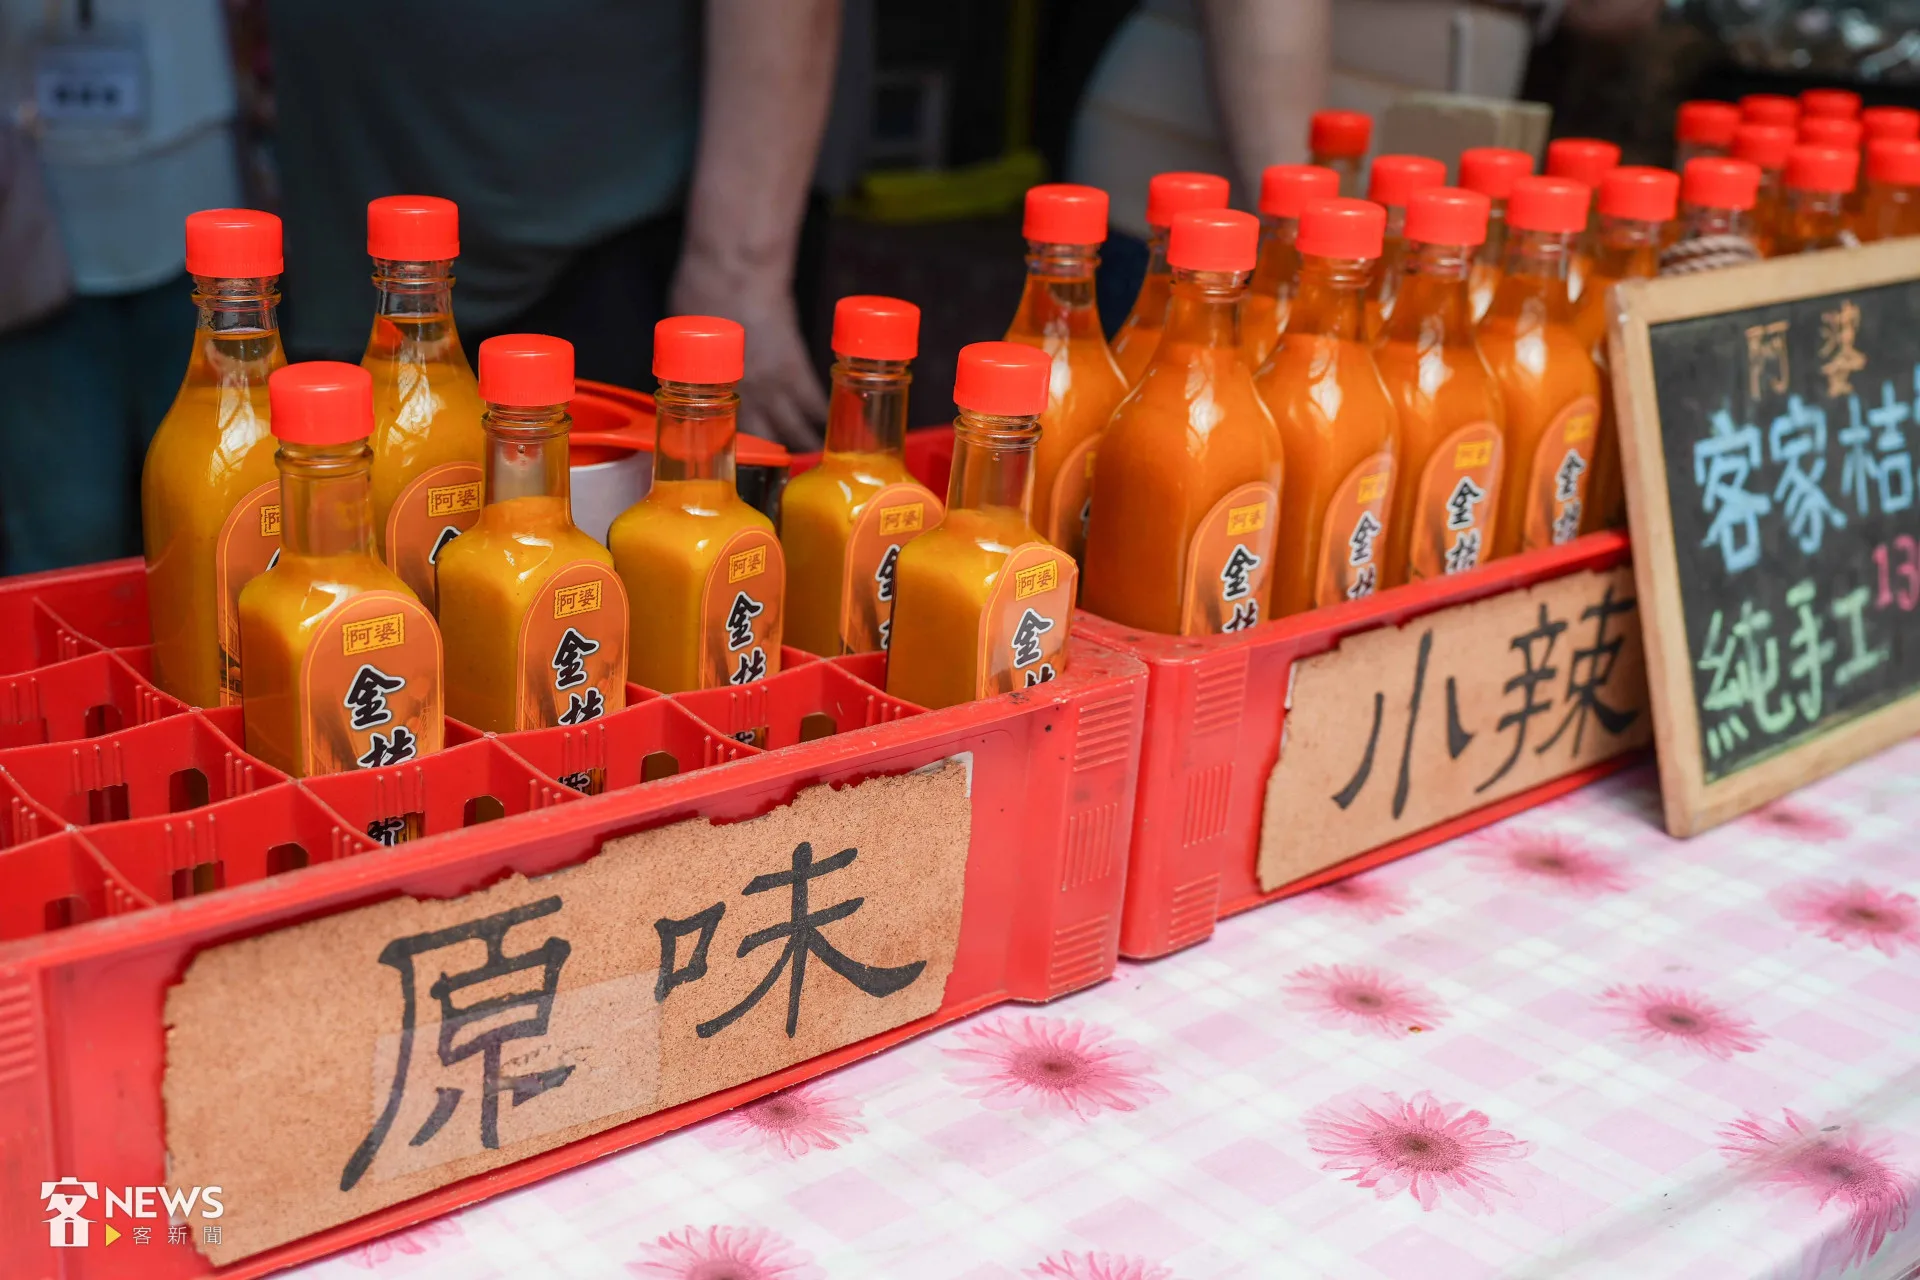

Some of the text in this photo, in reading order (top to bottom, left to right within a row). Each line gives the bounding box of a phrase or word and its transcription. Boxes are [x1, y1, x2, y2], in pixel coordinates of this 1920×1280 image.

[1693, 362, 1920, 574] 客家桔
[434, 487, 478, 510] 阿婆
[884, 508, 919, 530] 阿婆
[733, 552, 762, 578] 阿婆
[1872, 533, 1920, 610] 13
[1019, 567, 1053, 595] 阿婆
[559, 586, 597, 613] 阿婆
[348, 620, 398, 649] 阿婆
[1699, 577, 1889, 760] 純手工
[1331, 584, 1640, 820] 小辣
[340, 840, 928, 1192] 原味
